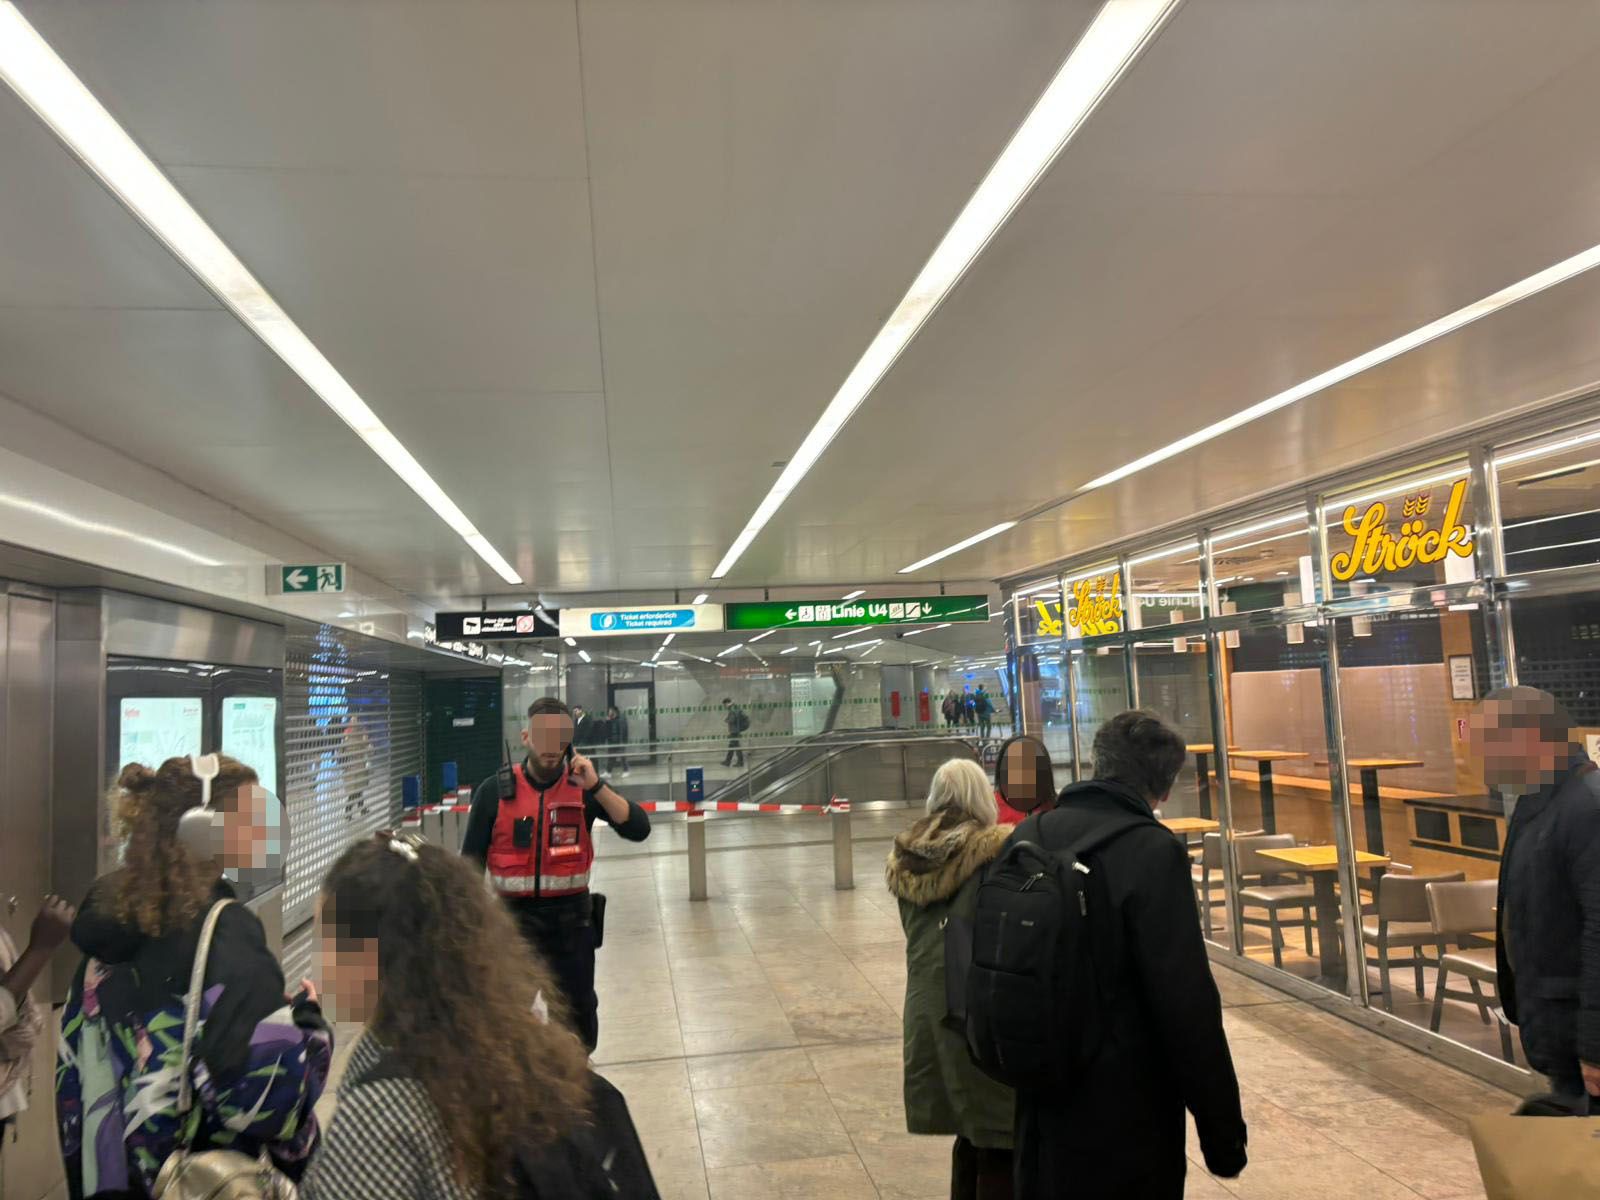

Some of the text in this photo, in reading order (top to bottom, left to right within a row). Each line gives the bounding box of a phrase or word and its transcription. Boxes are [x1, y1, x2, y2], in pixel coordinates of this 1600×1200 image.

[1330, 478, 1473, 581] Ströck
[640, 612, 677, 620] erforderlich
[832, 604, 888, 618] Linie U4
[1069, 571, 1123, 628] Ströck
